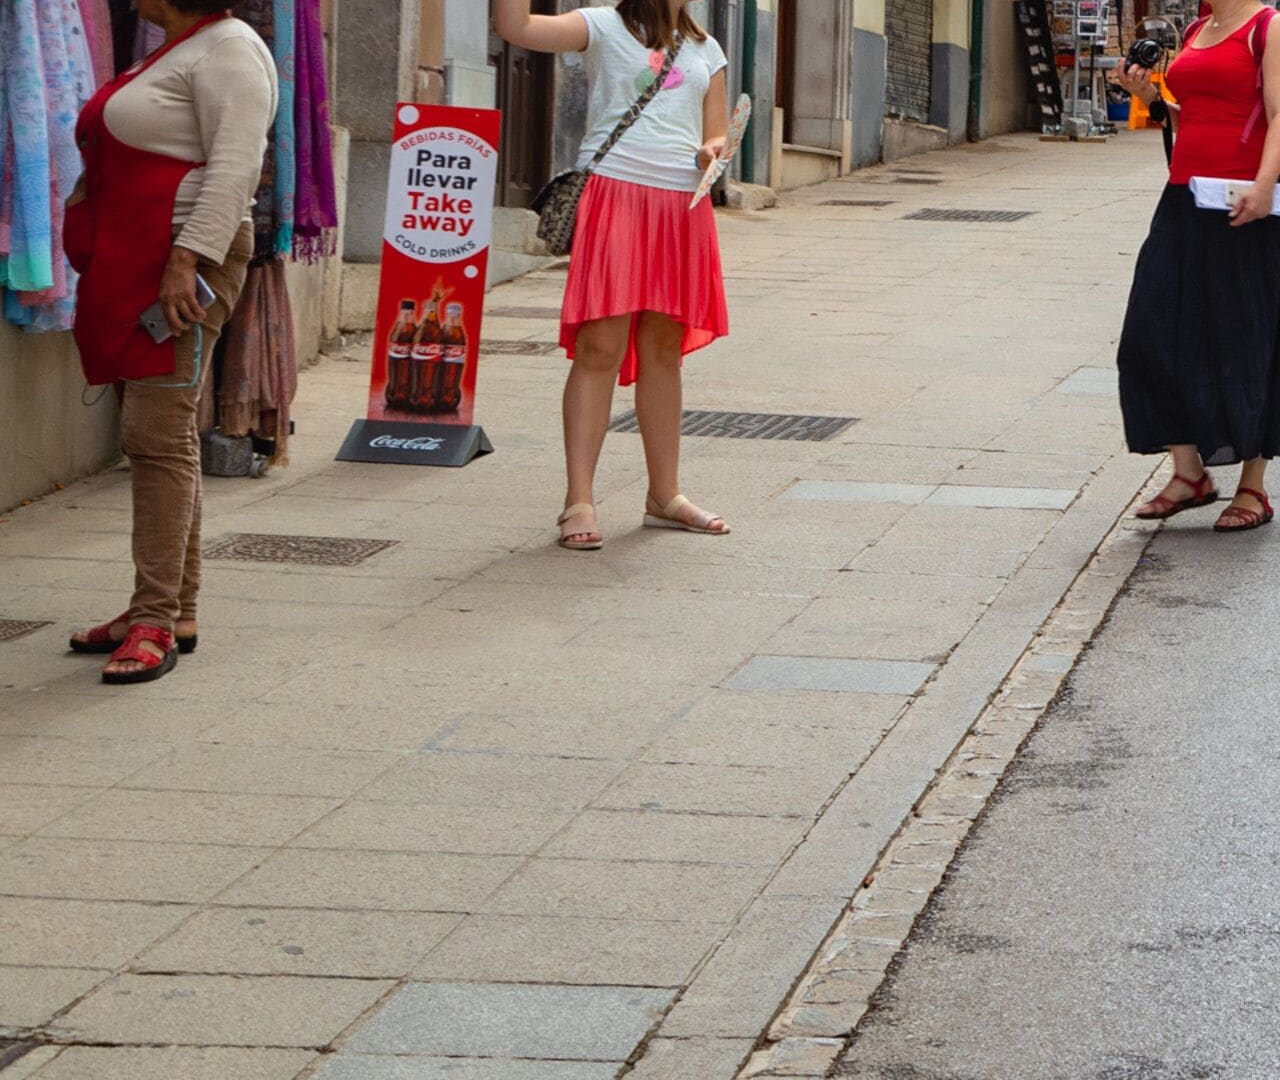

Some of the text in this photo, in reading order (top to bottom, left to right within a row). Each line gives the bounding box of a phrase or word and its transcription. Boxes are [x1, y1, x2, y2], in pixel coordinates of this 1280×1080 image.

[400, 131, 493, 160] BEBIDAS FRÍAS
[416, 149, 471, 171] Para
[407, 168, 478, 191] llevar
[408, 191, 473, 215] Take
[401, 215, 474, 238] away
[394, 233, 477, 259] COLD DRINKS
